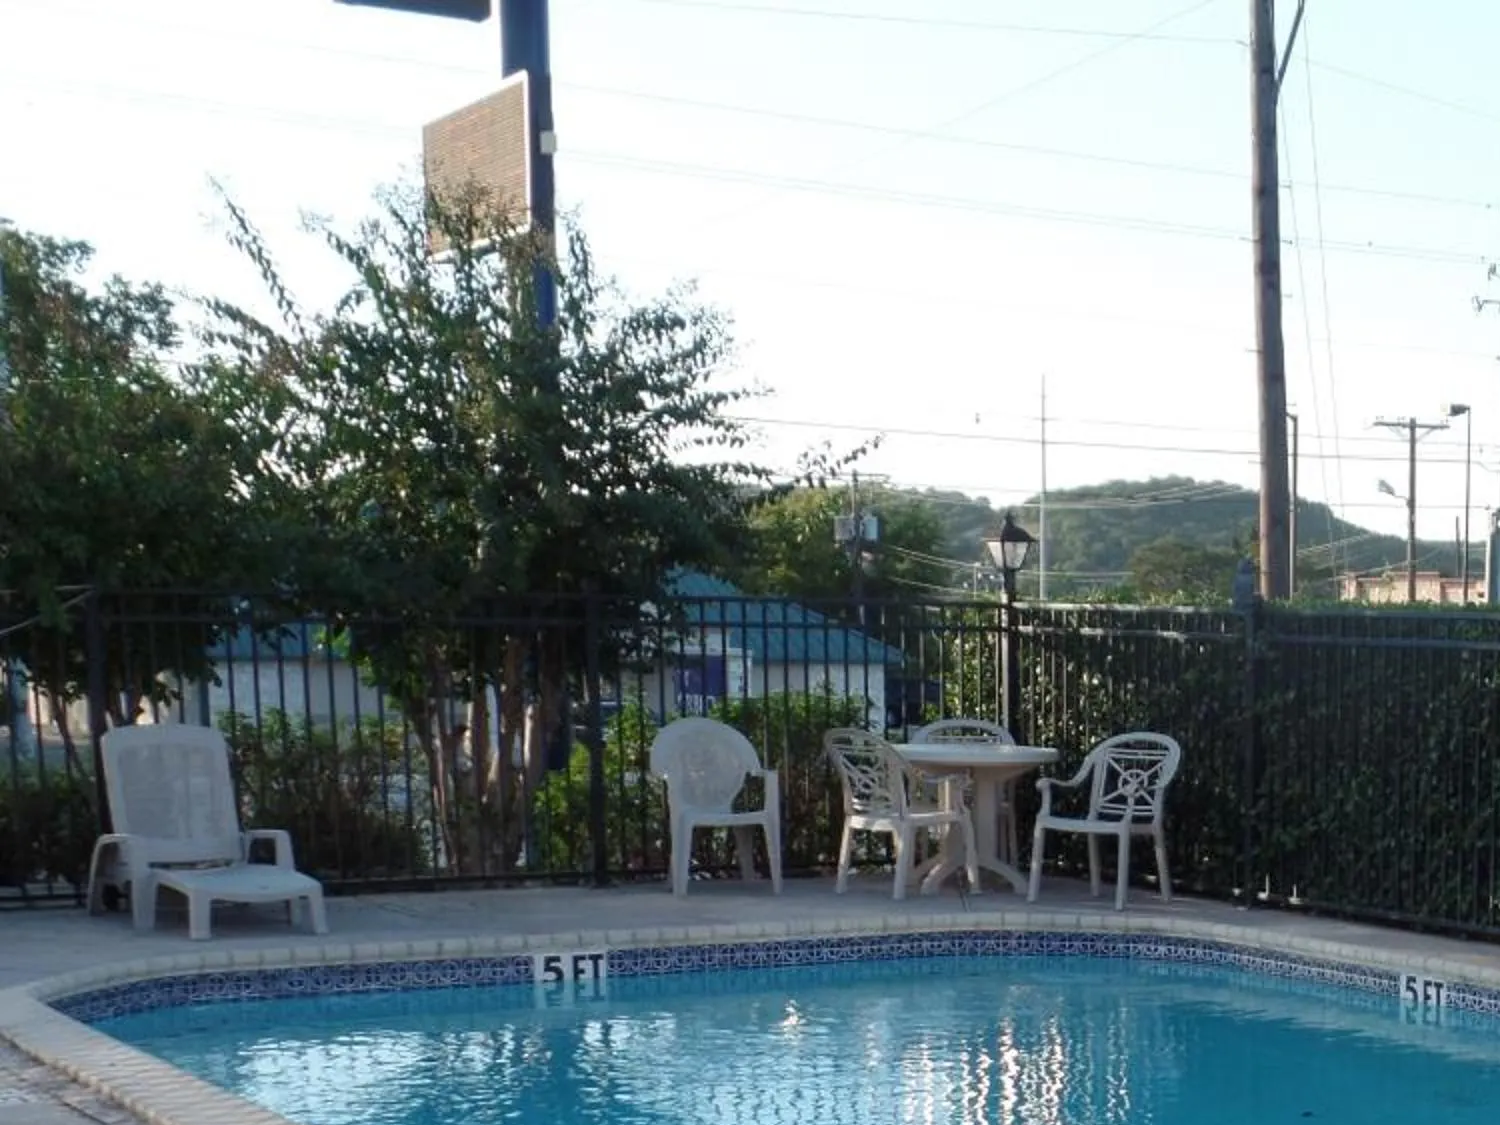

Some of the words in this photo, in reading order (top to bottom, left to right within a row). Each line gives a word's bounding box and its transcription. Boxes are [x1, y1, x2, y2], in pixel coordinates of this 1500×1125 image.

[543, 956, 564, 982] 5
[573, 953, 604, 980] FT
[1405, 975, 1418, 1007] 5
[1423, 979, 1444, 1006] FT
